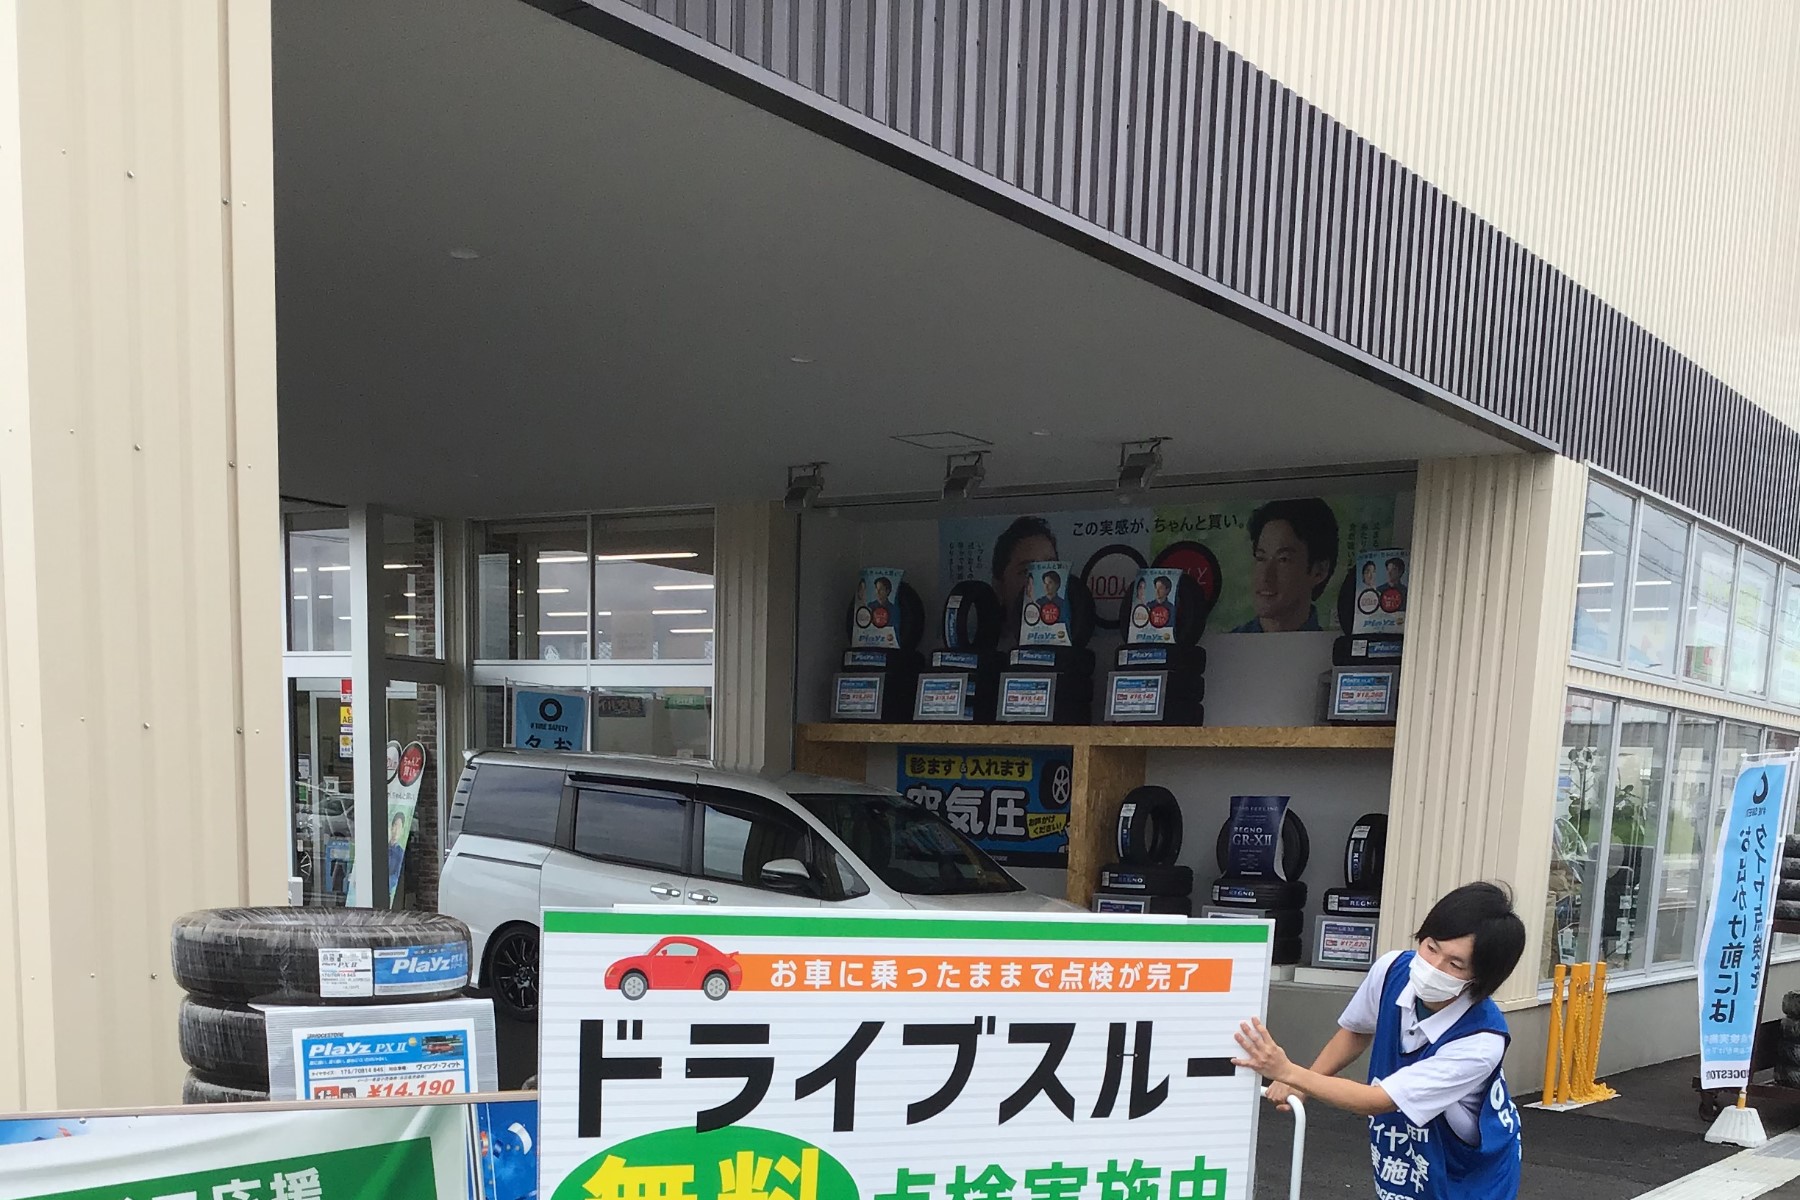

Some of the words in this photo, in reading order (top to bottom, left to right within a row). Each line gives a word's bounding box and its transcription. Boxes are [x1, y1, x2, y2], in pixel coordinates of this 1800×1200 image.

[1072, 513, 1245, 536] この実感が、ちゃんと買い。
[970, 759, 1029, 777] 入れます
[391, 956, 451, 975] Playz
[770, 958, 1200, 992] お車に乗ったままで点検が完了
[309, 1041, 371, 1057] Playz
[577, 1015, 1238, 1138] ドライブスルー
[367, 1078, 455, 1099] ¥14,190
